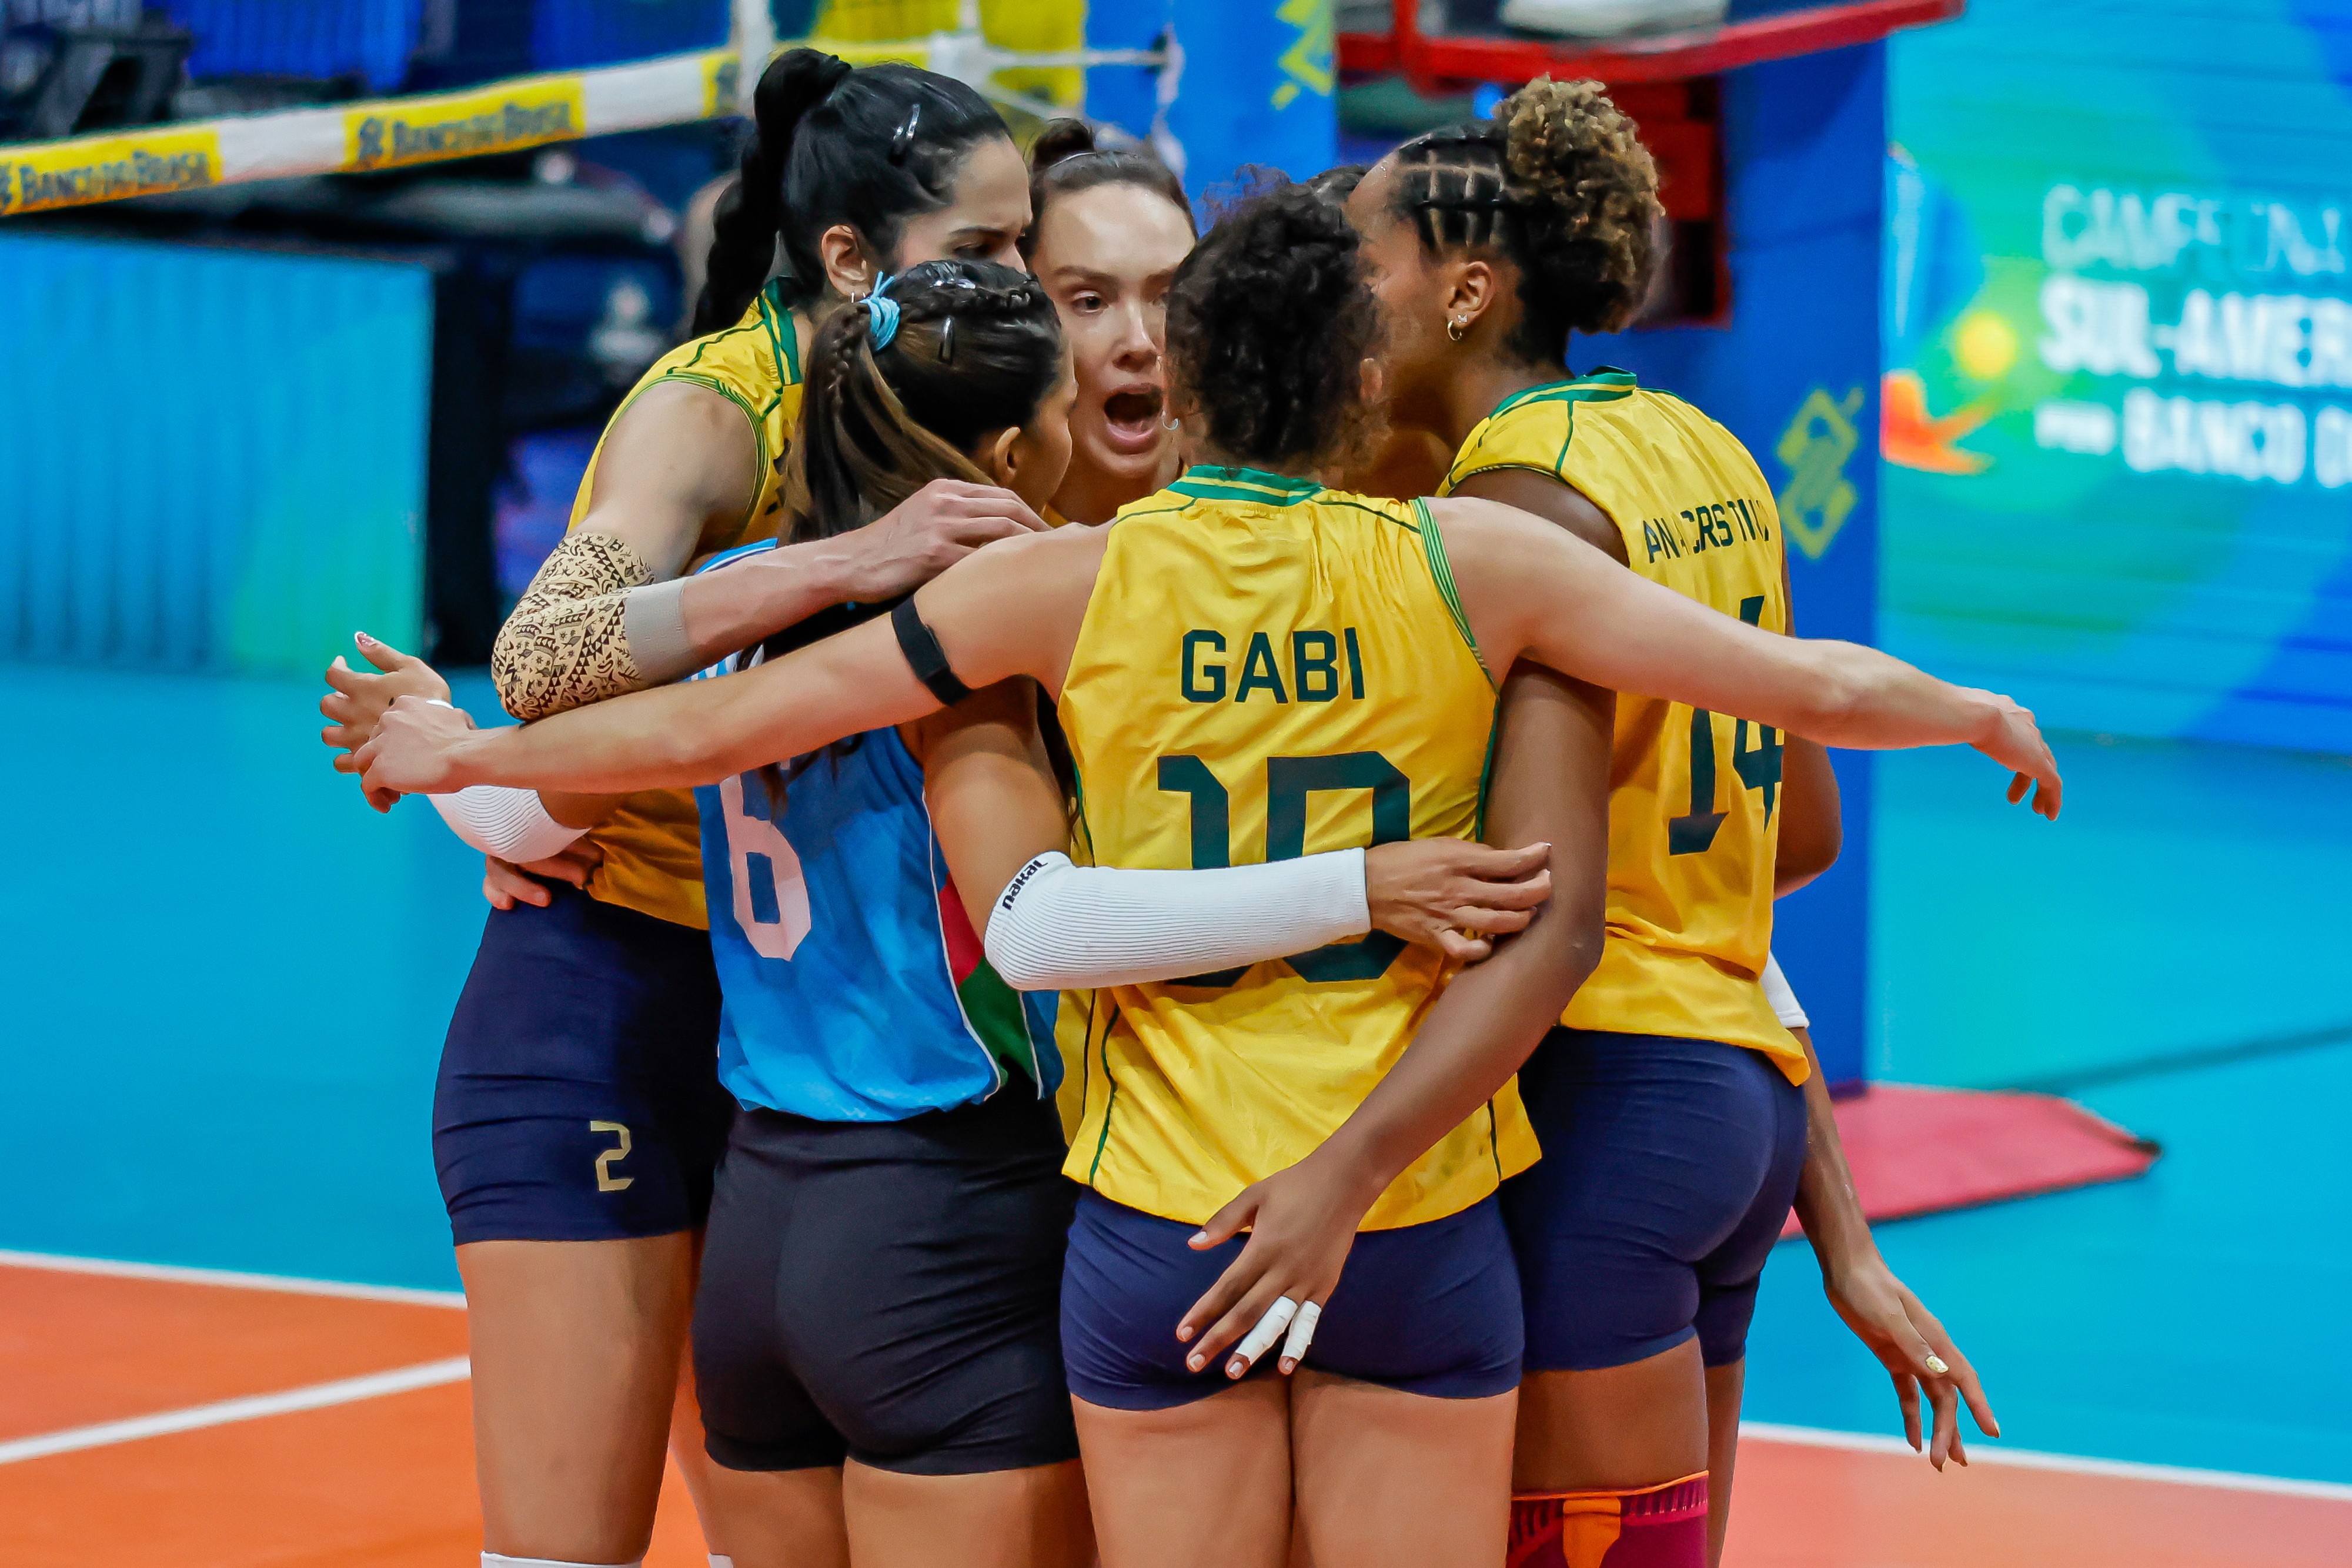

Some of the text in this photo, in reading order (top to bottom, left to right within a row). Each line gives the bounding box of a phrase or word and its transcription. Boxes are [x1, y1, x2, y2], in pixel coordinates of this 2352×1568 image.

[1181, 627, 1366, 704] GABI
[1668, 595, 1784, 856] 14
[719, 760, 812, 962] 6
[1157, 751, 1411, 988] 10
[590, 1120, 635, 1192] 2
